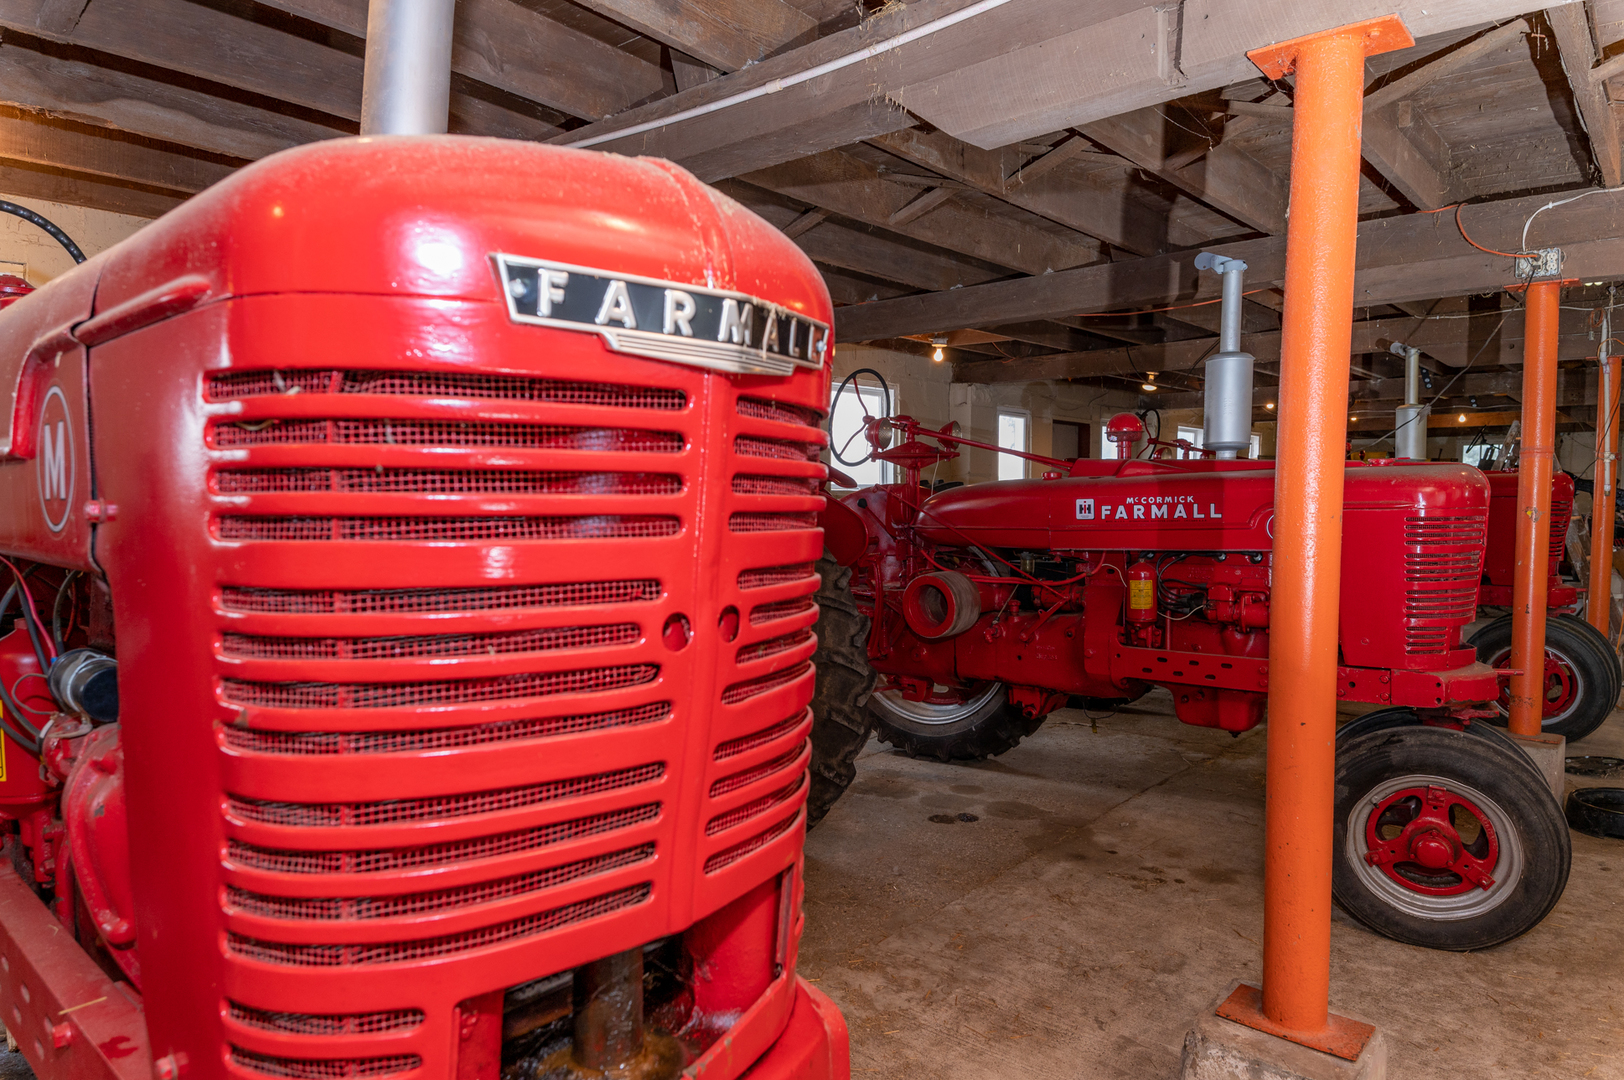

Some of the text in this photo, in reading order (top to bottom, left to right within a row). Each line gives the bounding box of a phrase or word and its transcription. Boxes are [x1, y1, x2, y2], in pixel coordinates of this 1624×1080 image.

[536, 267, 818, 364] FARMALL
[44, 420, 66, 501] M
[1101, 503, 1222, 520] FARMALL
